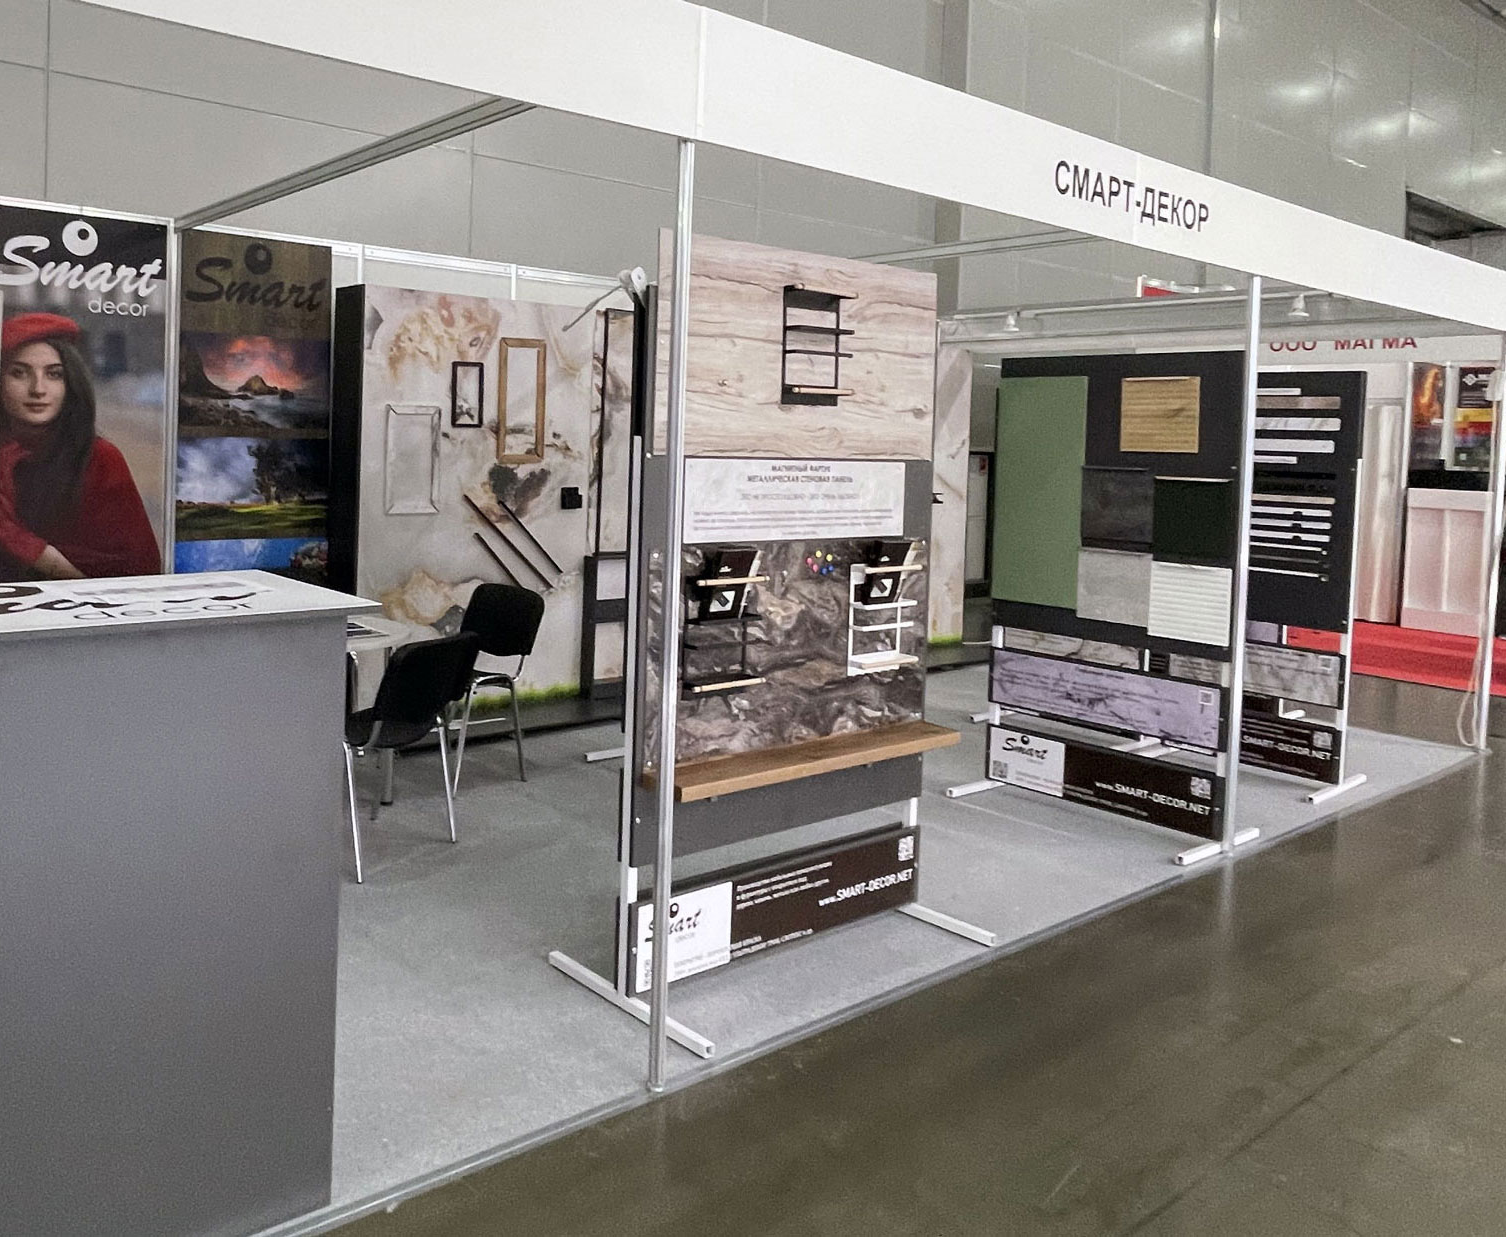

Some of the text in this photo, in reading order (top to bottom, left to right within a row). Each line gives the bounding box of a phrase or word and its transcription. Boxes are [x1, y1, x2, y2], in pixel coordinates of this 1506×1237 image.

[1054, 160, 1210, 232] СМАРТ-ДЕКОР
[88, 298, 149, 318] decor
[185, 256, 328, 312] Smart
